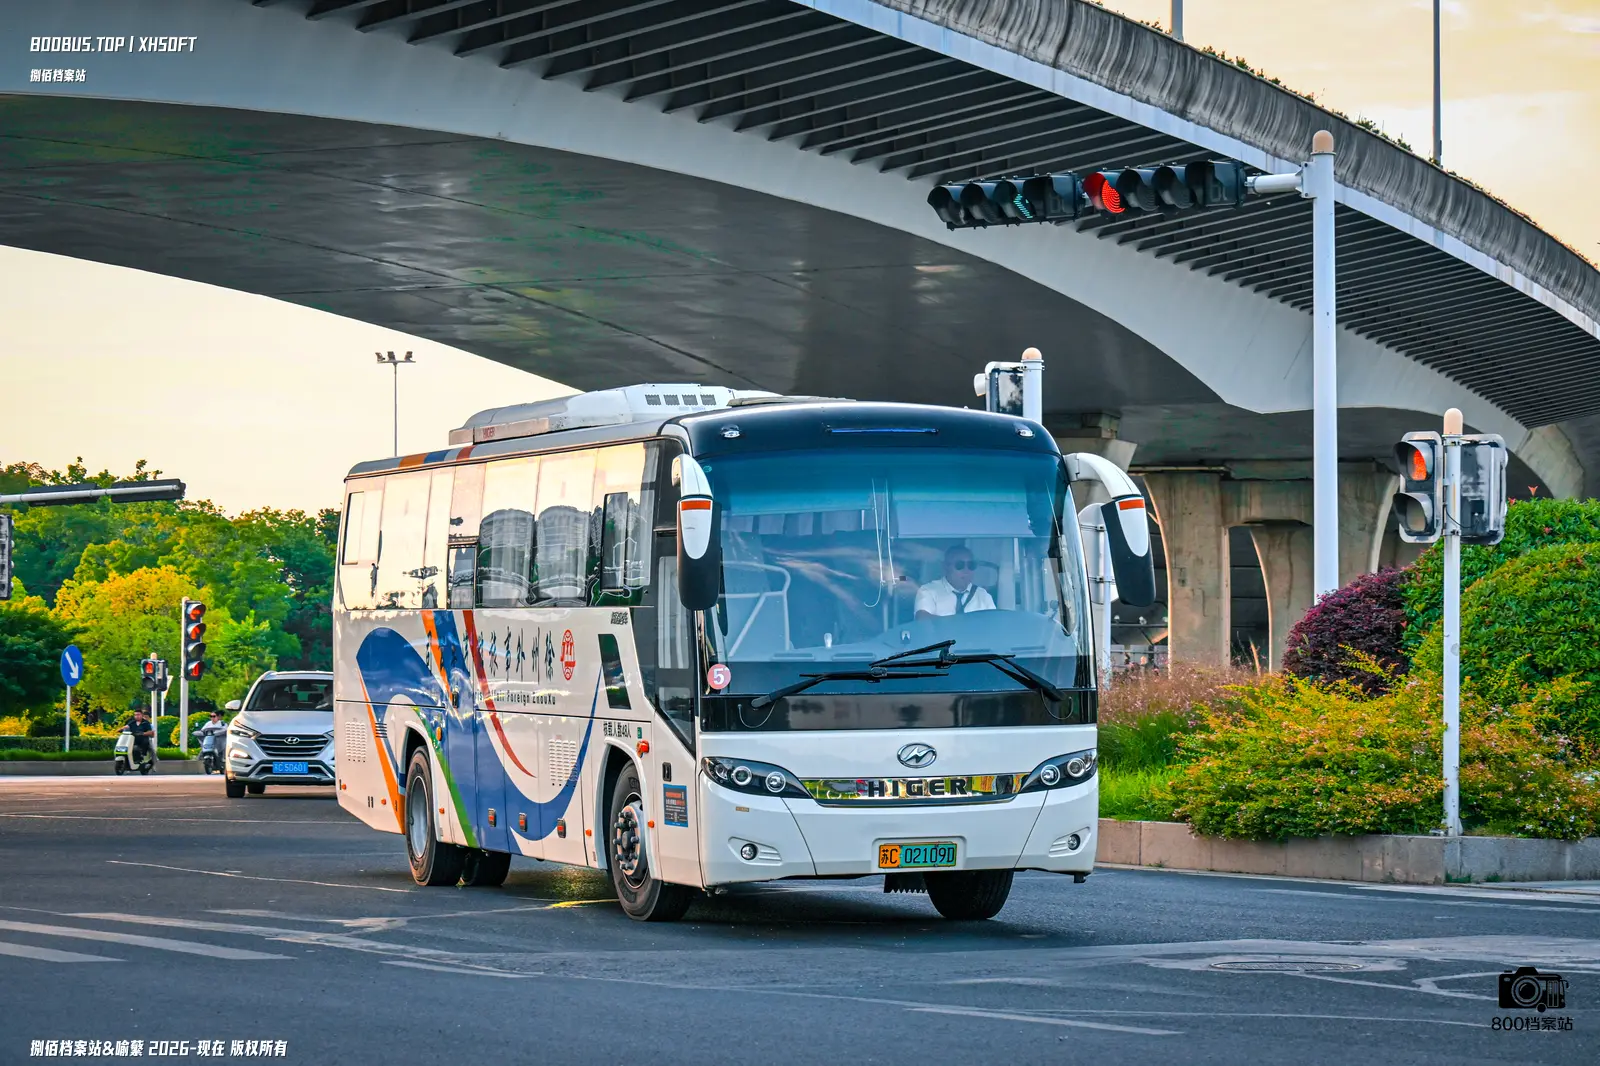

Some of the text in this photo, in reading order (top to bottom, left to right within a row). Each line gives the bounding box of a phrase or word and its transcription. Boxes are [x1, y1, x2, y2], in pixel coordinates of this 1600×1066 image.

[713, 668, 725, 685] 5
[868, 779, 967, 797] HIGER
[904, 847, 955, 864] 02109D
